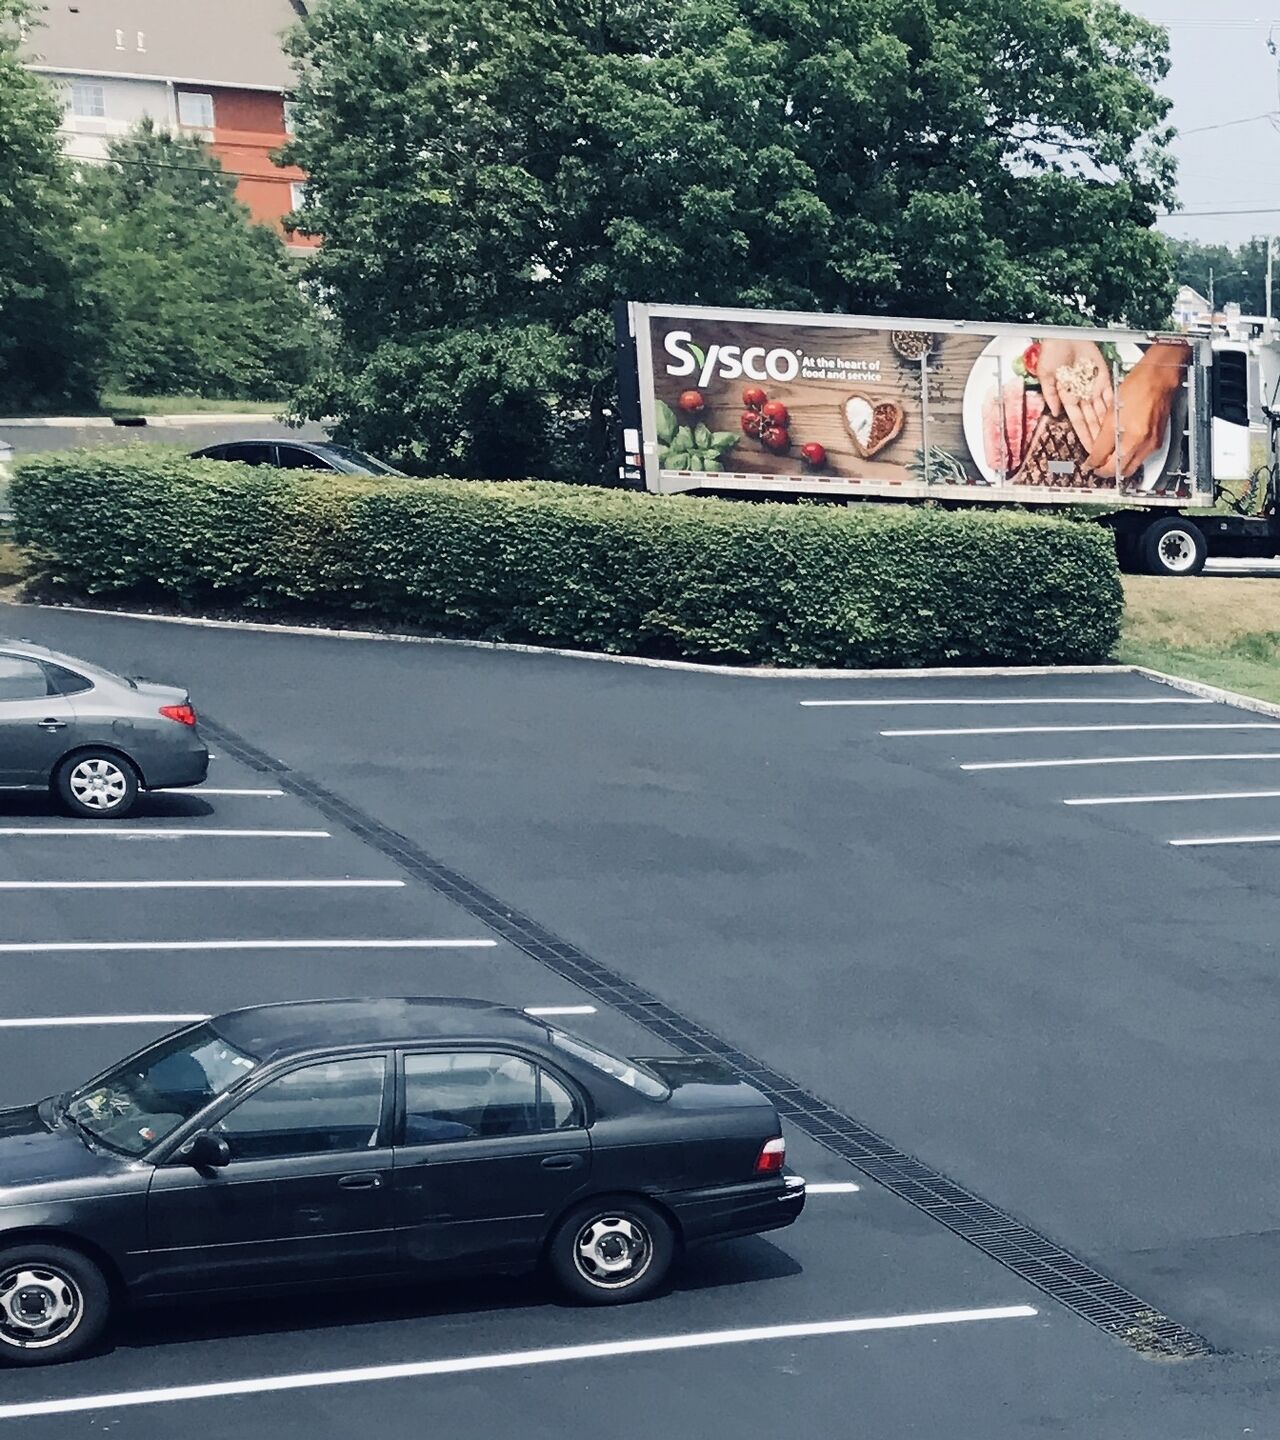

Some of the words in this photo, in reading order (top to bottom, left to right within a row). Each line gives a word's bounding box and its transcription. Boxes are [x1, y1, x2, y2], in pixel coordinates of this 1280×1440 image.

[802, 356, 815, 367] At
[816, 357, 835, 368] the
[836, 358, 867, 370] heart
[868, 360, 880, 370] of
[801, 367, 826, 378] food
[827, 369, 846, 379] and
[847, 371, 881, 381] service
